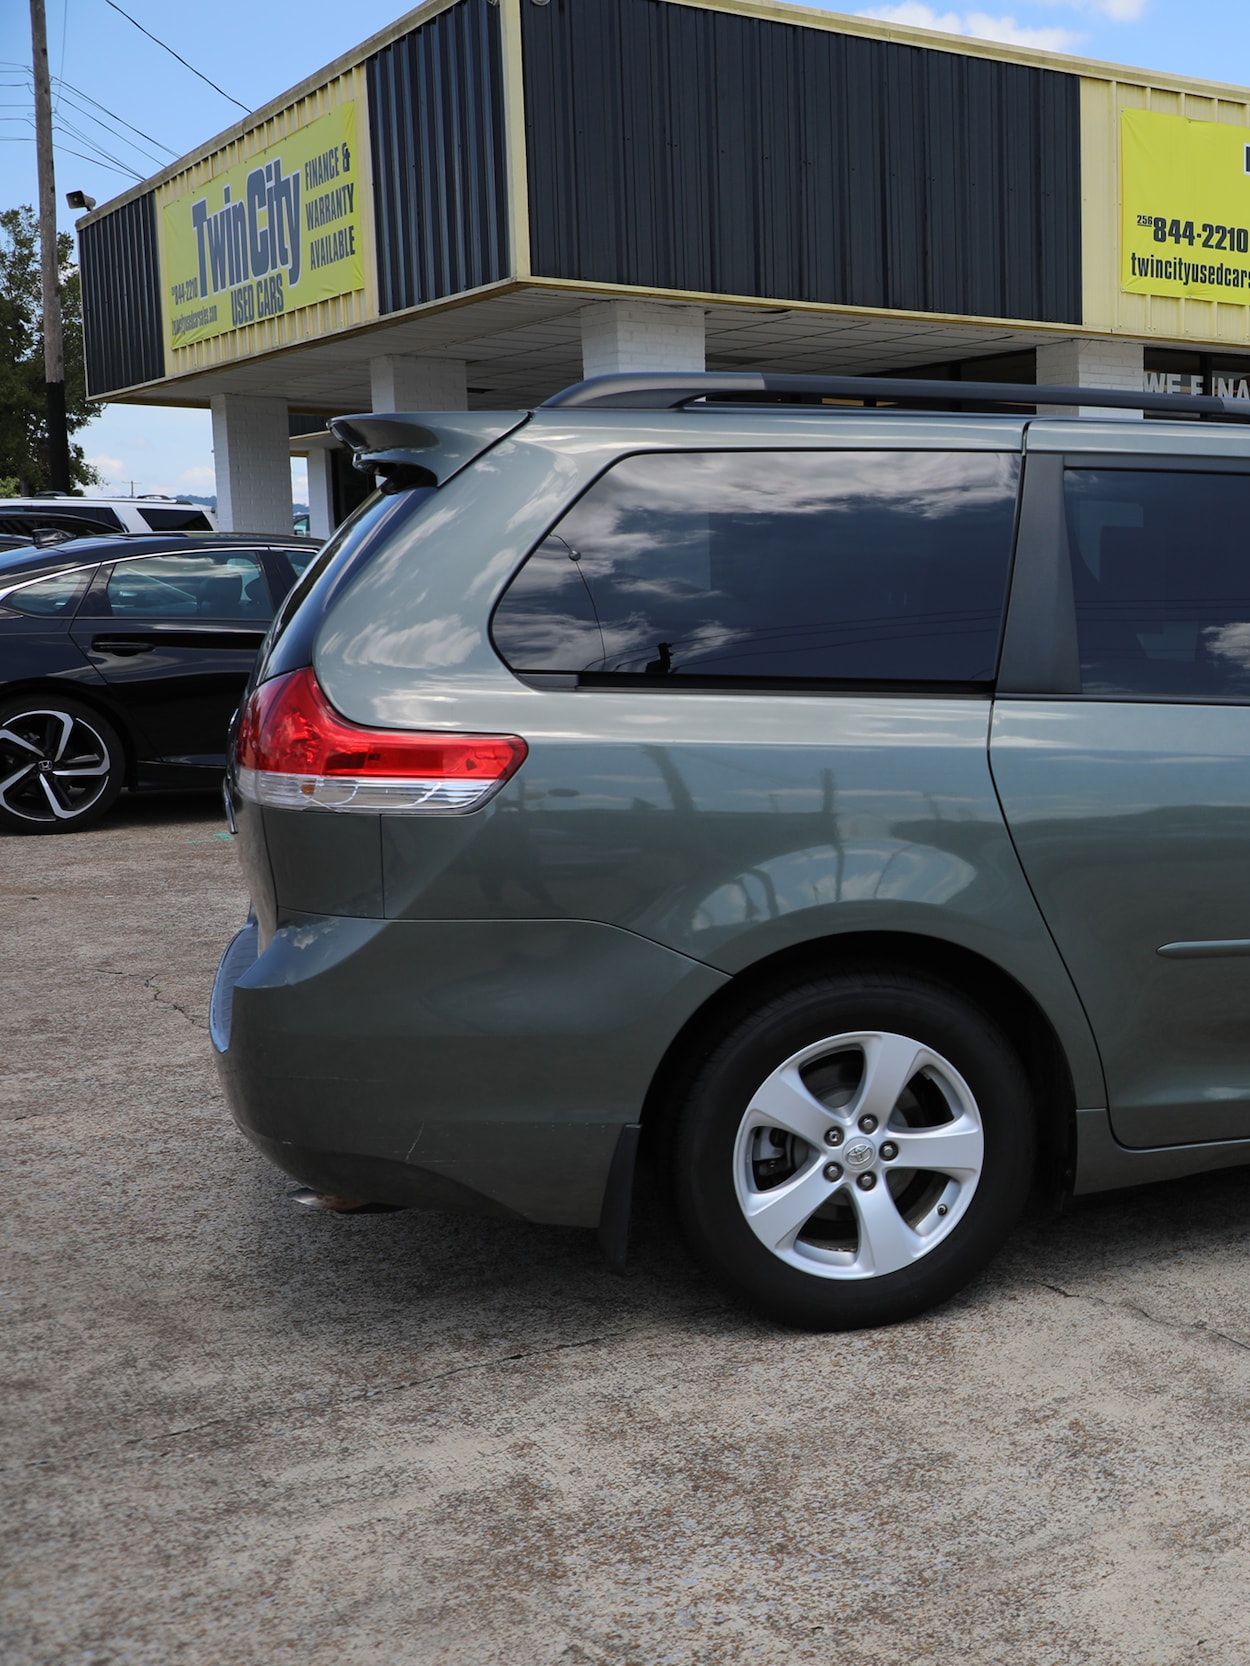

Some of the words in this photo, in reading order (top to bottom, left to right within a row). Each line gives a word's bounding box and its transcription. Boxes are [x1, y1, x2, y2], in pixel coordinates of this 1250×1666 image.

[304, 146, 339, 191] FINANCE
[342, 142, 350, 172] &
[305, 182, 354, 231] WARRANTY
[1136, 214, 1153, 227] 256
[310, 225, 355, 271] AVAILABLE
[230, 284, 255, 327] USED
[256, 273, 284, 318] CARS
